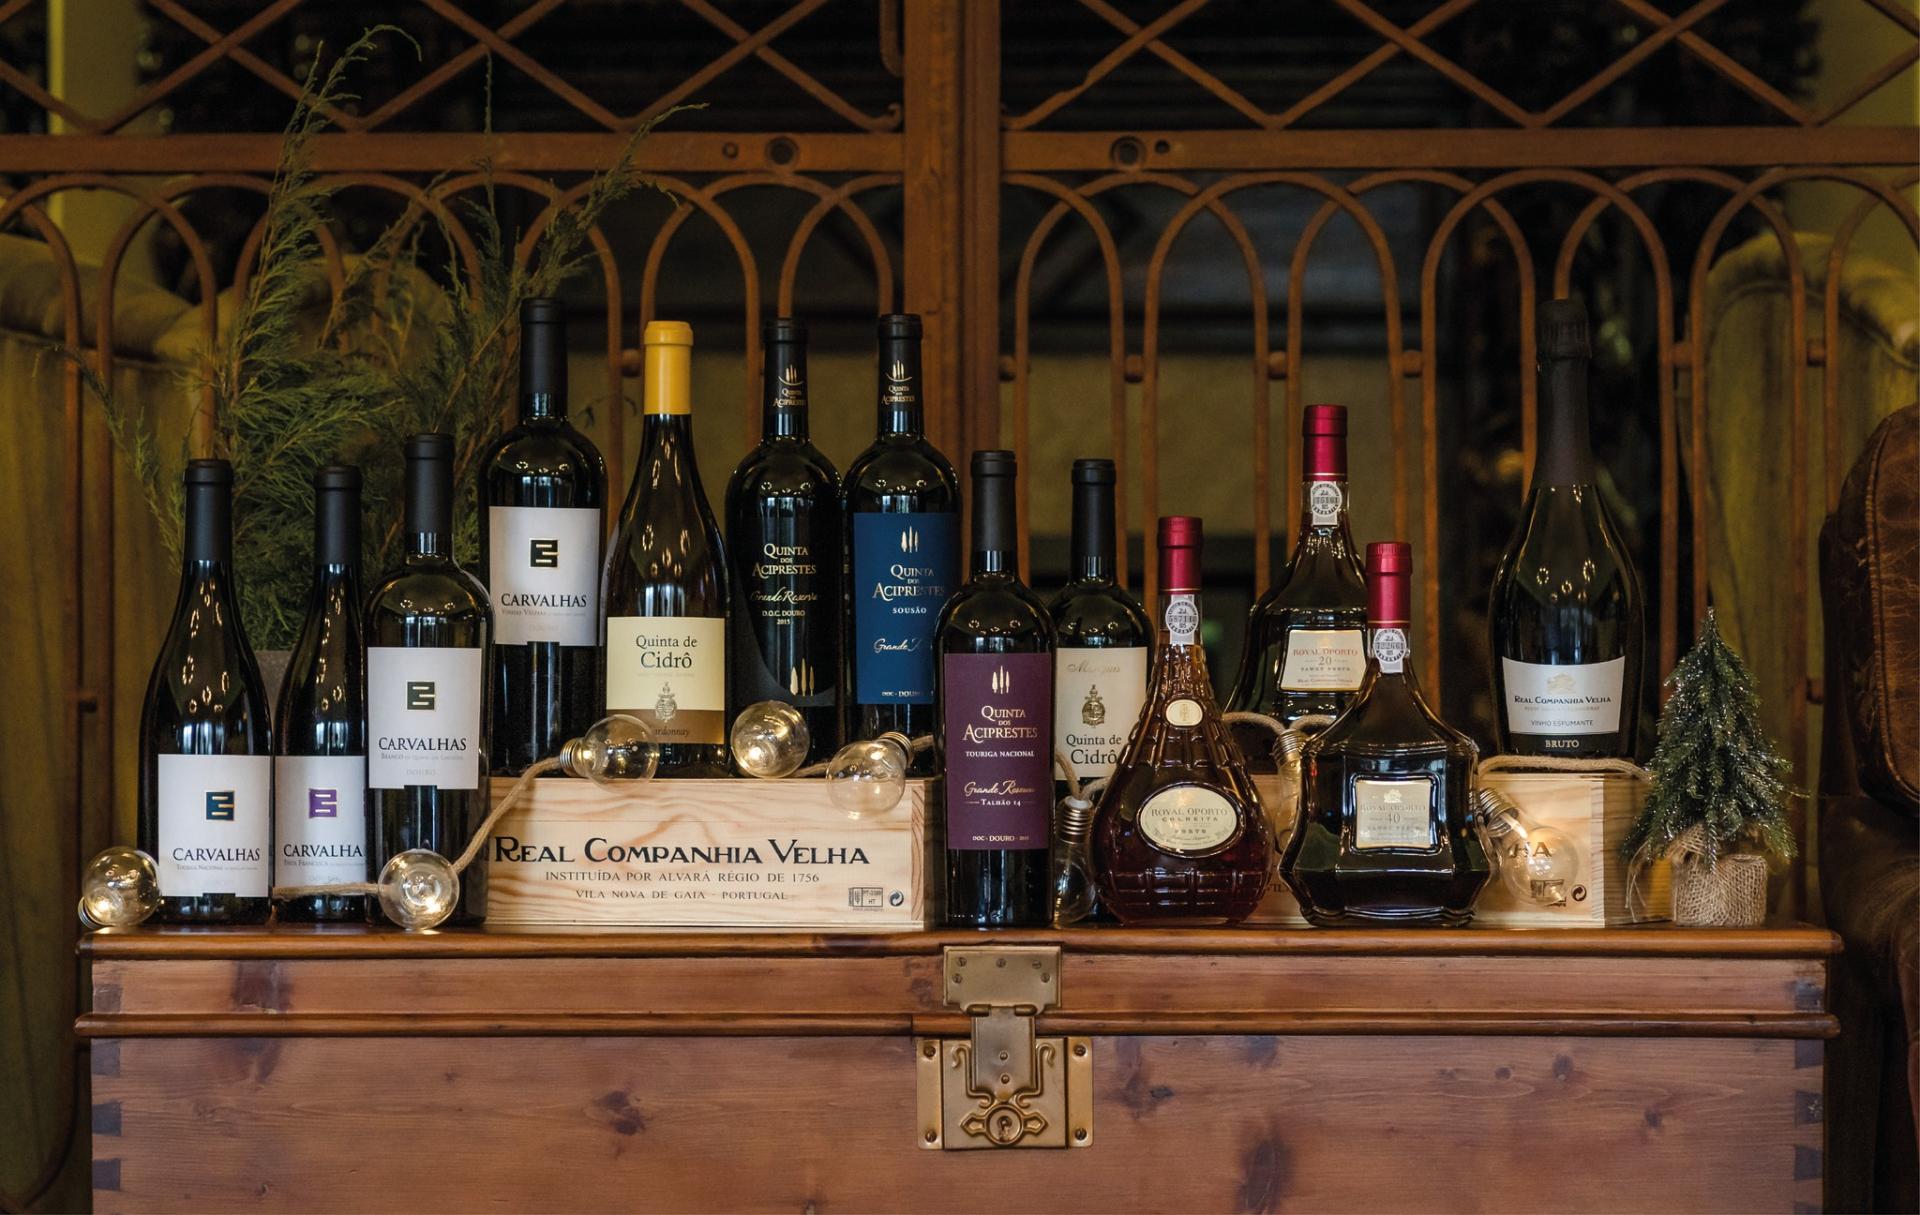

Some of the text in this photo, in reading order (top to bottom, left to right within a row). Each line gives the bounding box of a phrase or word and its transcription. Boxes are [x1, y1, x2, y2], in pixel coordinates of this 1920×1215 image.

[763, 543, 809, 559] QUINTA
[752, 562, 817, 579] ACIPRESTES
[890, 564, 934, 580] QUINTA
[872, 582, 944, 602] ACIPRESTES
[501, 593, 587, 607] CARVALHAS
[892, 606, 927, 614] SOUSÃO
[636, 635, 698, 649] Quinta de
[873, 638, 908, 654] Grande
[641, 651, 692, 669] Cidrô
[1318, 656, 1332, 666] 20
[1514, 696, 1611, 704] REAL COMPANHIA VELHA
[981, 705, 1026, 722] QUINTA
[962, 723, 1038, 743] ACIPRESTES
[379, 737, 467, 751] CARVALHAS
[1066, 734, 1122, 747] Quinta de
[1545, 740, 1579, 748] BRUTO
[1071, 749, 1118, 765] Cidrô
[964, 781, 998, 797] Grande
[1152, 807, 1228, 817] ROYAL OPORTO
[173, 848, 260, 861] CARVALHAS
[284, 844, 365, 857] CARVALHA
[495, 836, 870, 864] REAL COMPANHIA VELHA
[545, 869, 820, 883] INSTITUÍDA POR ALVARÁ RÉGIO DE 1756
[576, 890, 605, 899] VILA
[611, 890, 645, 899] NOVA
[652, 891, 668, 899] DE
[674, 891, 705, 900] GAIA
[722, 892, 788, 901] PORTUGAL
